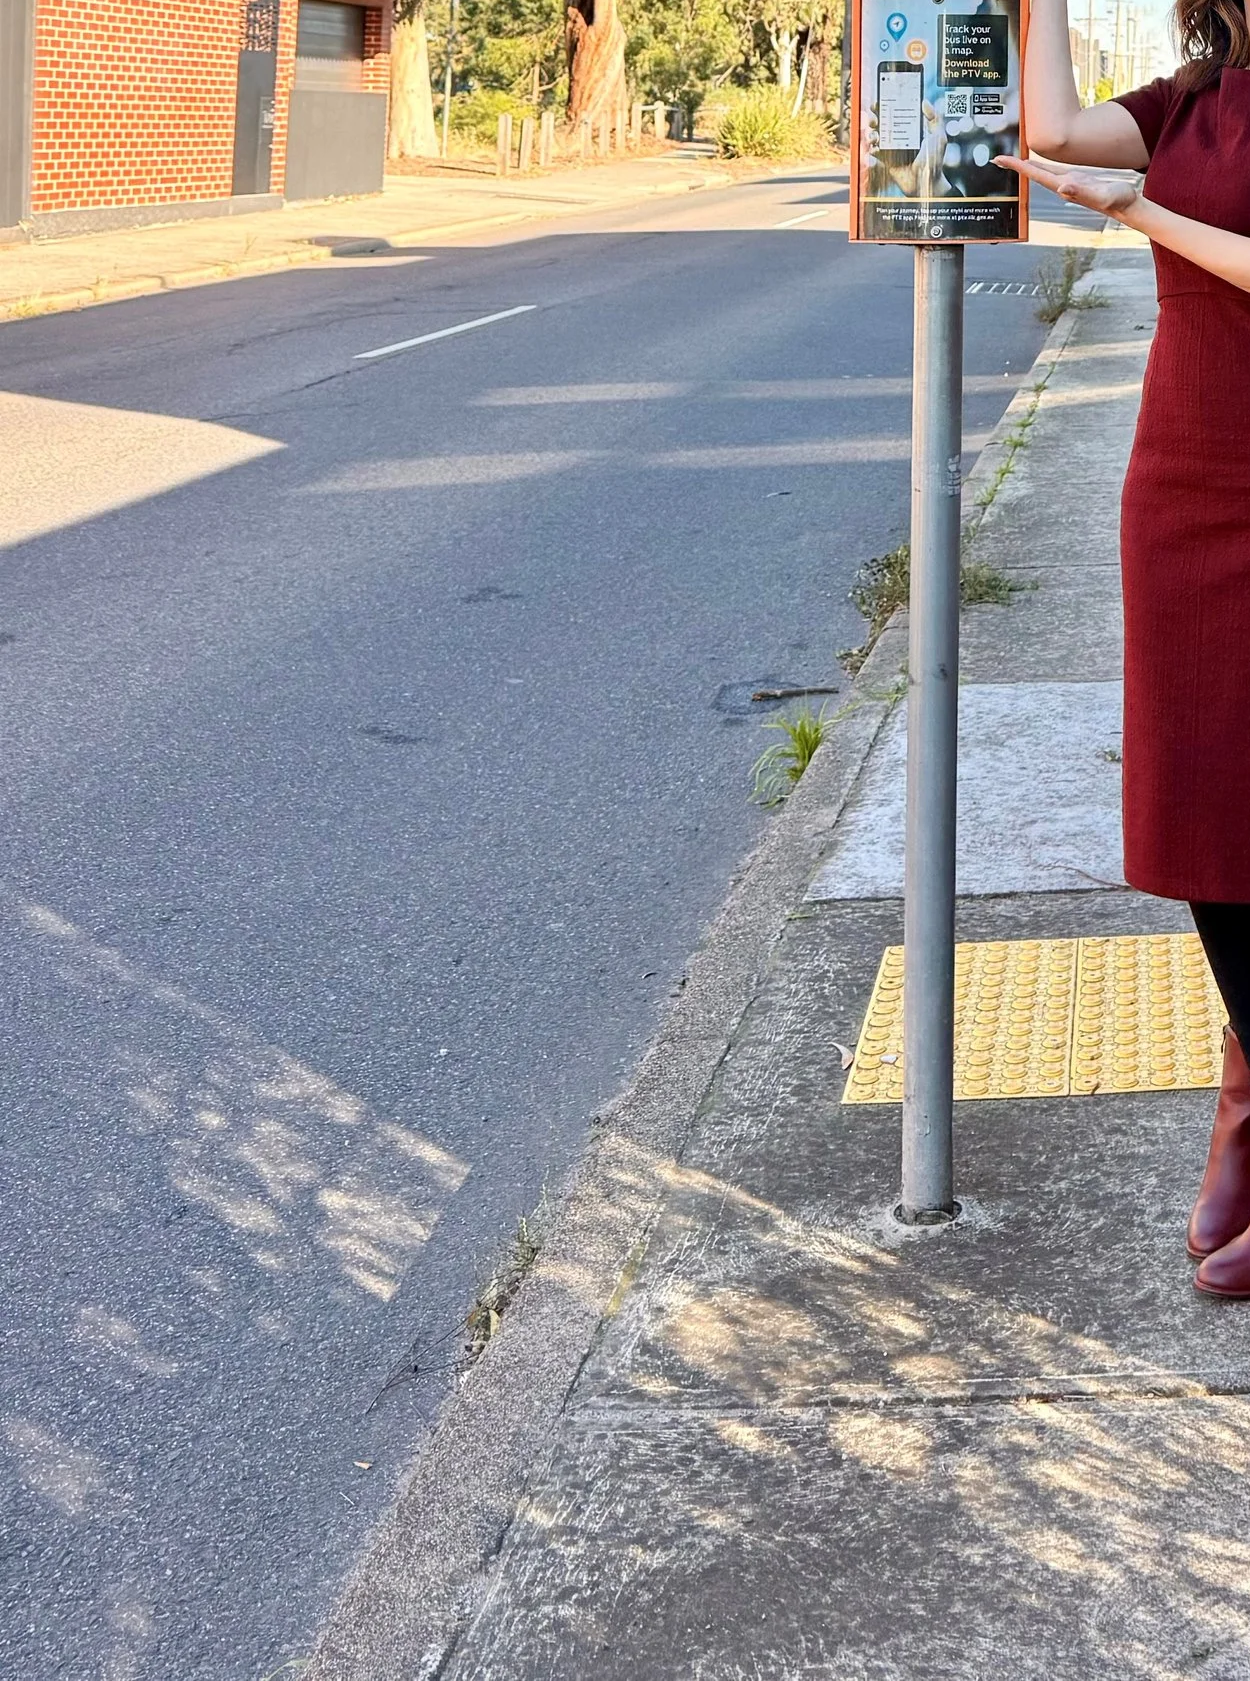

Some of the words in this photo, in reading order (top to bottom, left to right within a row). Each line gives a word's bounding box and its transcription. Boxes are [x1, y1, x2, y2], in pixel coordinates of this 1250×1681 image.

[945, 24, 969, 33] Track
[971, 26, 991, 35] your
[962, 35, 978, 44] live
[951, 48, 974, 56] map.
[944, 59, 990, 68] Download
[944, 70, 960, 78] the
[961, 70, 981, 78] PTV
